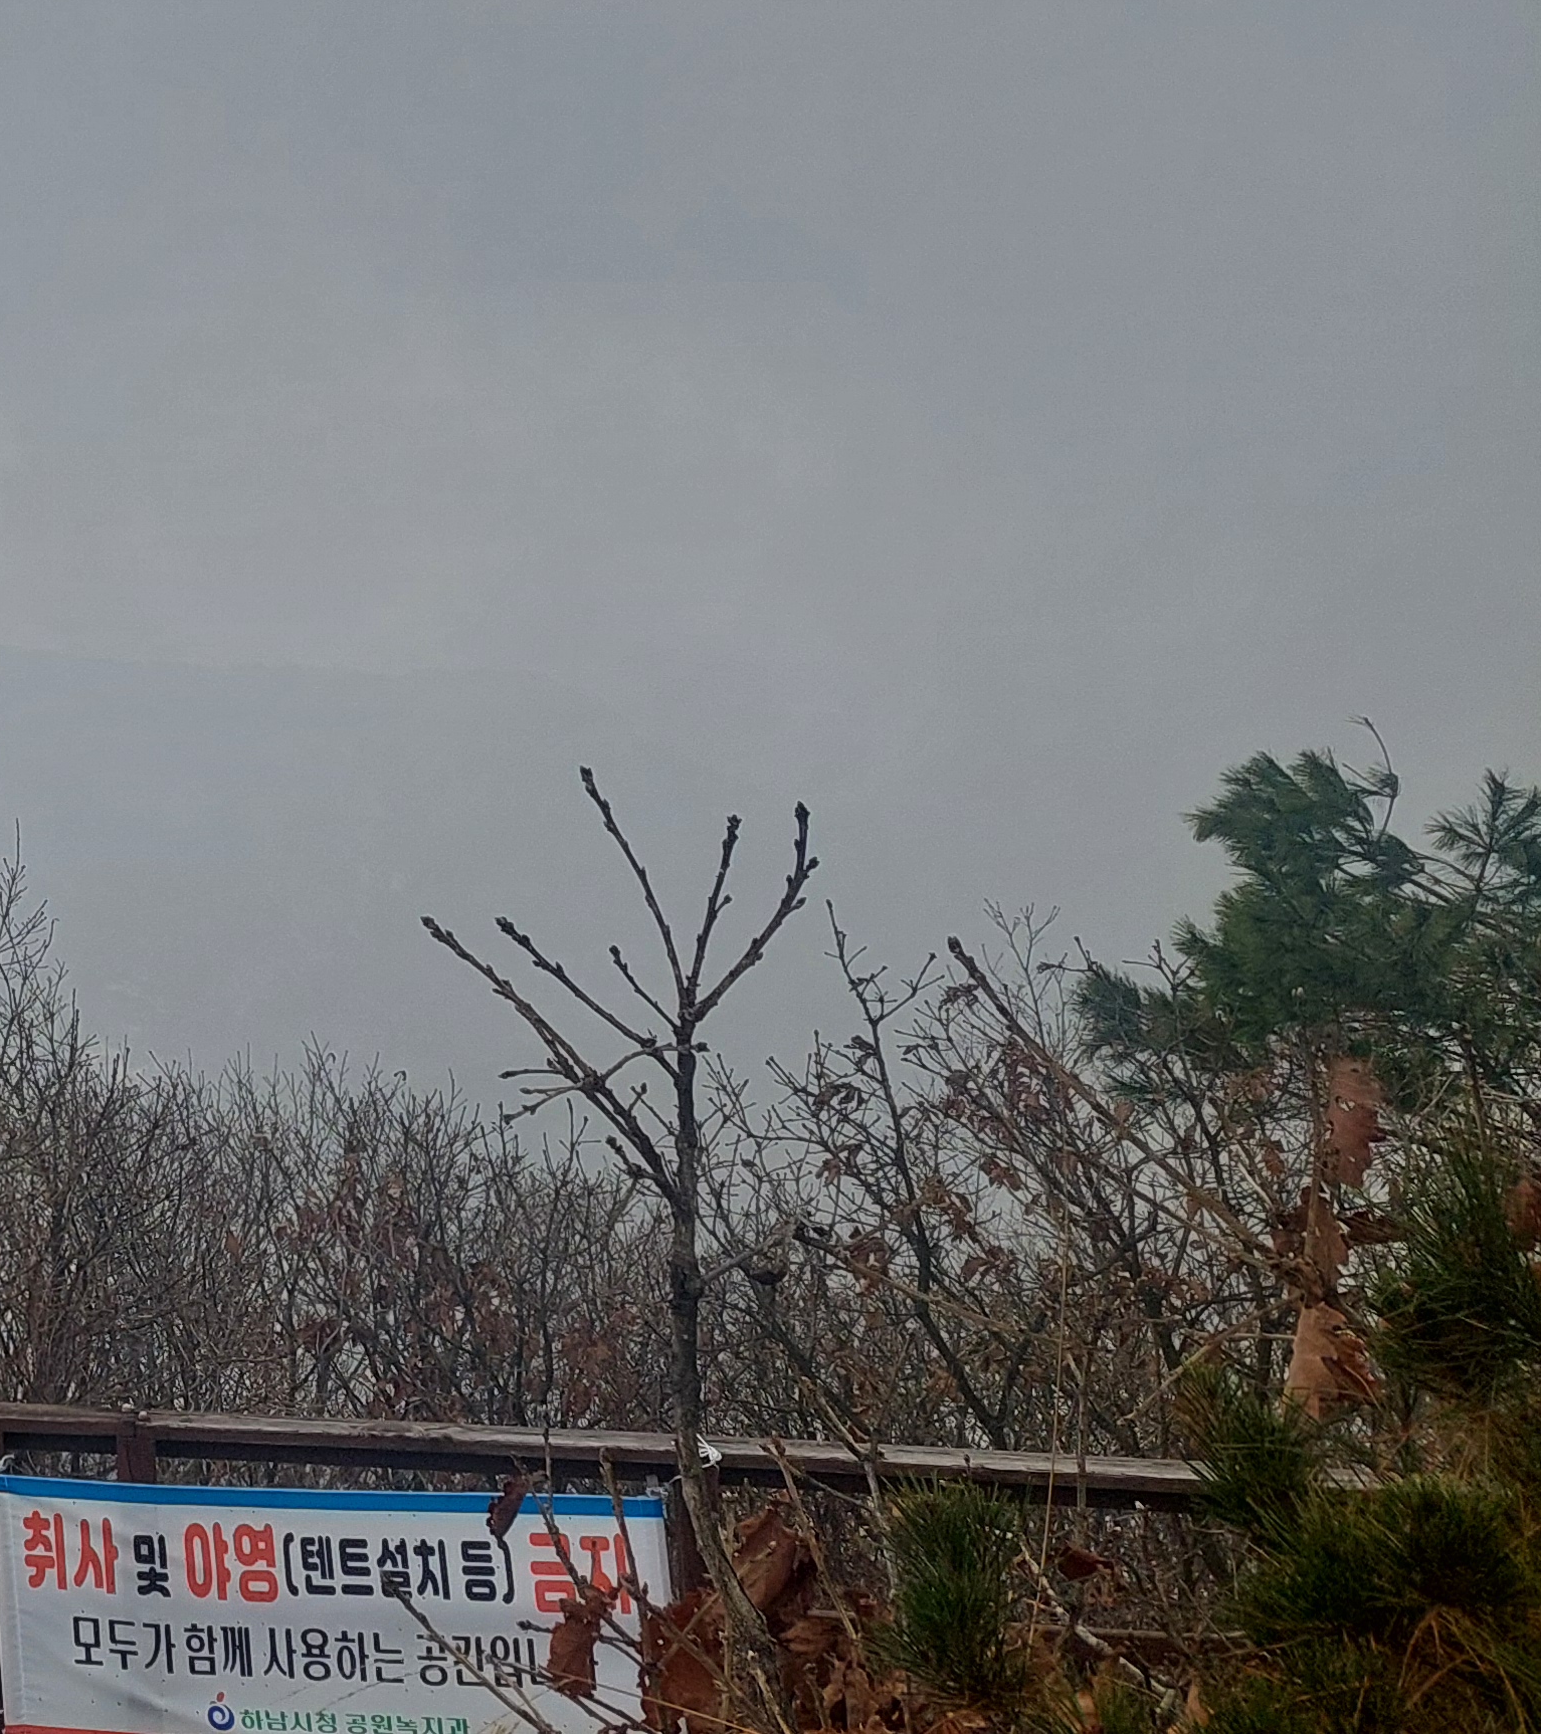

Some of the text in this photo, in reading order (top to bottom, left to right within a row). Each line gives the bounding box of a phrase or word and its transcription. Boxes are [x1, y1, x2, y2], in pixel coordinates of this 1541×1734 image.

[22, 1510, 119, 1594] 취사
[133, 1534, 171, 1598] 및
[529, 1533, 632, 1615] 금지
[264, 1627, 405, 1684] 사용하는
[239, 1709, 337, 1733] 하남시청
